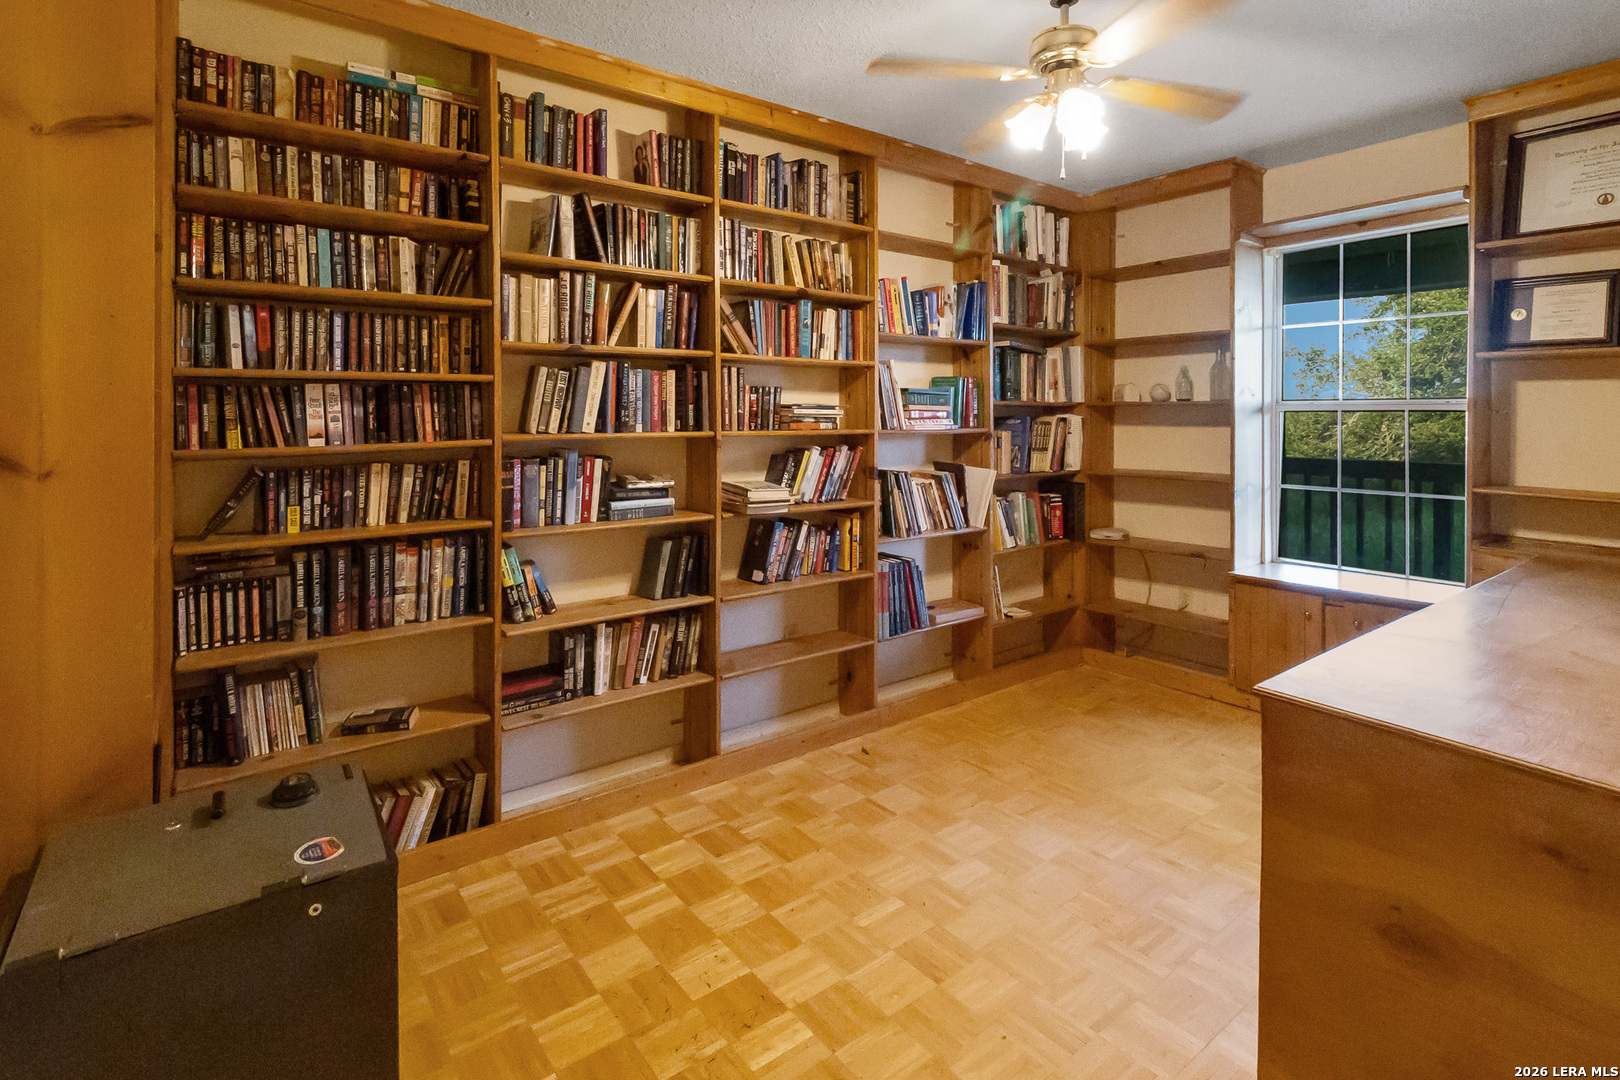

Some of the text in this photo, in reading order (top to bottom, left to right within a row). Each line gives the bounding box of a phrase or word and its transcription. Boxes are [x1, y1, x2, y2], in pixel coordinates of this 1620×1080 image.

[553, 373, 568, 411] LOST HIGHWAY
[358, 473, 367, 508] THE TOMB
